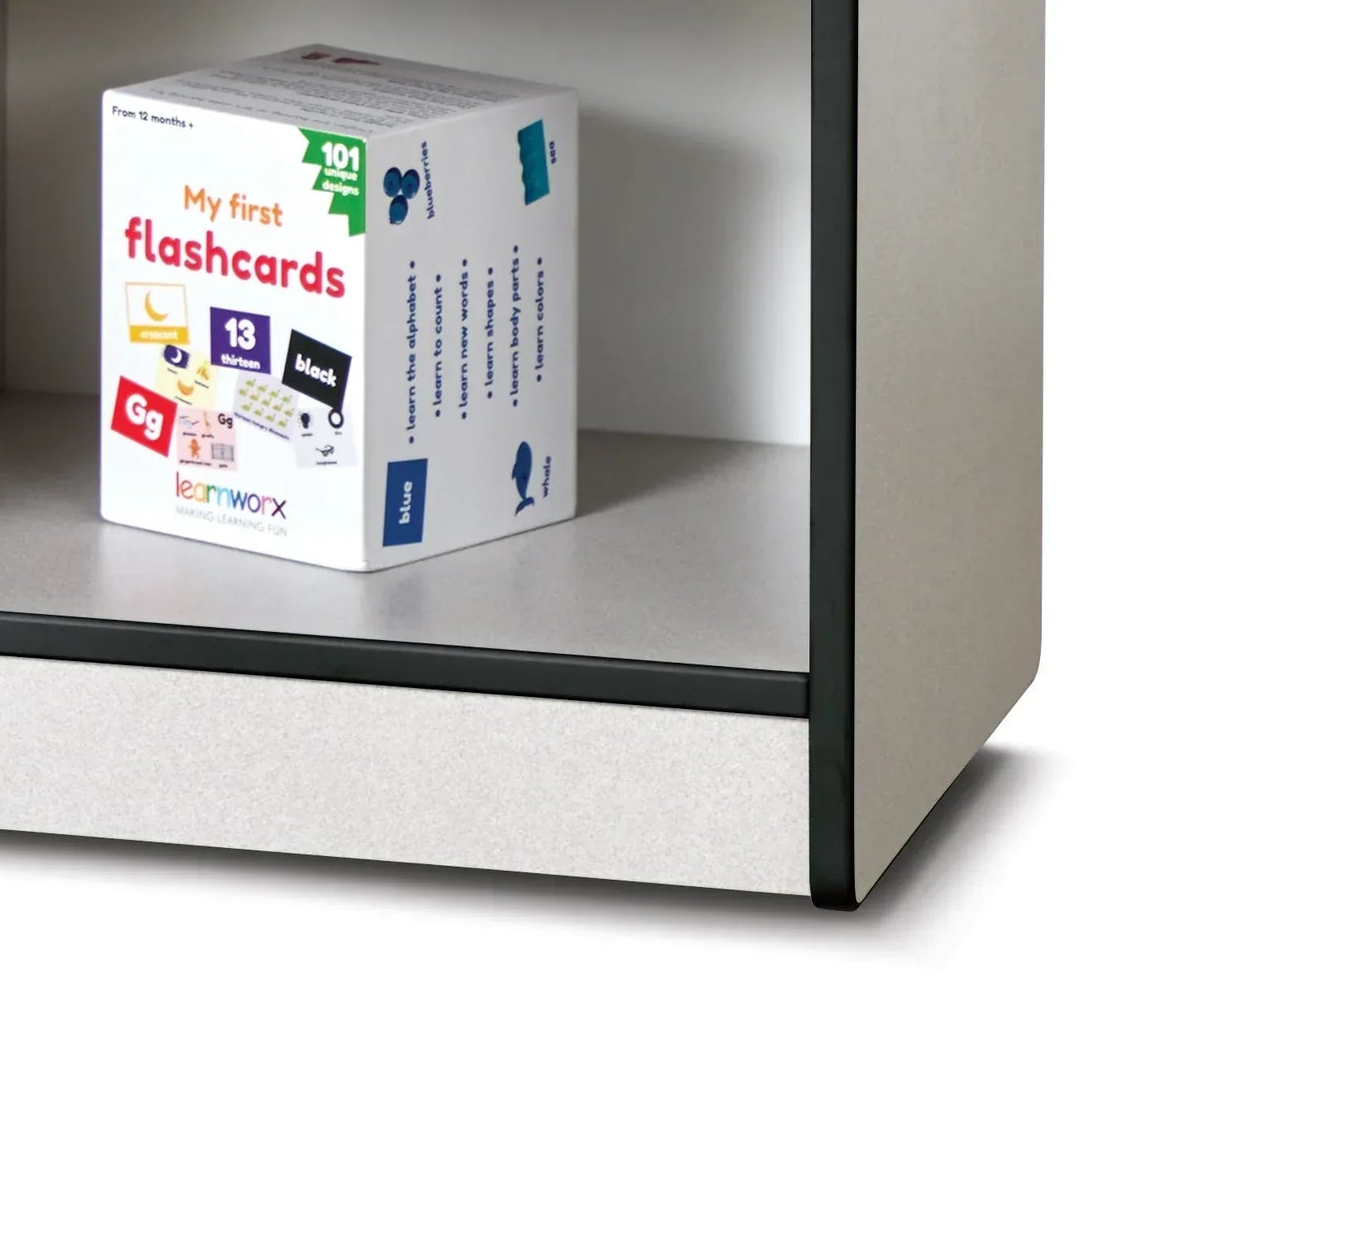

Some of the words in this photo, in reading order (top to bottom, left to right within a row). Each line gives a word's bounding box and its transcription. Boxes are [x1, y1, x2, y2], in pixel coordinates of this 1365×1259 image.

[111, 105, 137, 119] From
[138, 110, 149, 122] 12
[150, 114, 187, 129] months
[321, 141, 360, 171] 101
[324, 167, 358, 182] unique
[549, 141, 557, 164] sea
[322, 180, 360, 197] designs
[420, 141, 435, 220] blueberries
[184, 184, 222, 222] My
[230, 193, 283, 227] first
[125, 216, 345, 298] flashcards
[459, 271, 469, 321] words
[511, 257, 521, 302] parts
[535, 270, 544, 321] colors
[406, 274, 418, 349] alphabet
[434, 287, 442, 334] count
[485, 279, 496, 337] shapes
[510, 307, 521, 348] body
[224, 317, 257, 350] 13
[433, 339, 442, 357] to
[535, 325, 544, 370] learn
[221, 353, 261, 370] thirteen
[295, 353, 337, 387] black
[406, 353, 416, 382] the
[433, 360, 442, 406] learn
[484, 341, 493, 386] learn
[510, 351, 519, 396] learn
[406, 385, 416, 430] learn
[458, 363, 468, 408] learn
[125, 393, 164, 441] Gg
[218, 413, 233, 429] Gg
[175, 471, 286, 519] learnworx
[542, 455, 552, 498] whale
[175, 506, 214, 522] MAKING
[217, 515, 264, 532] LEARNING
[268, 524, 287, 537] FUN
[399, 481, 413, 524] blue
